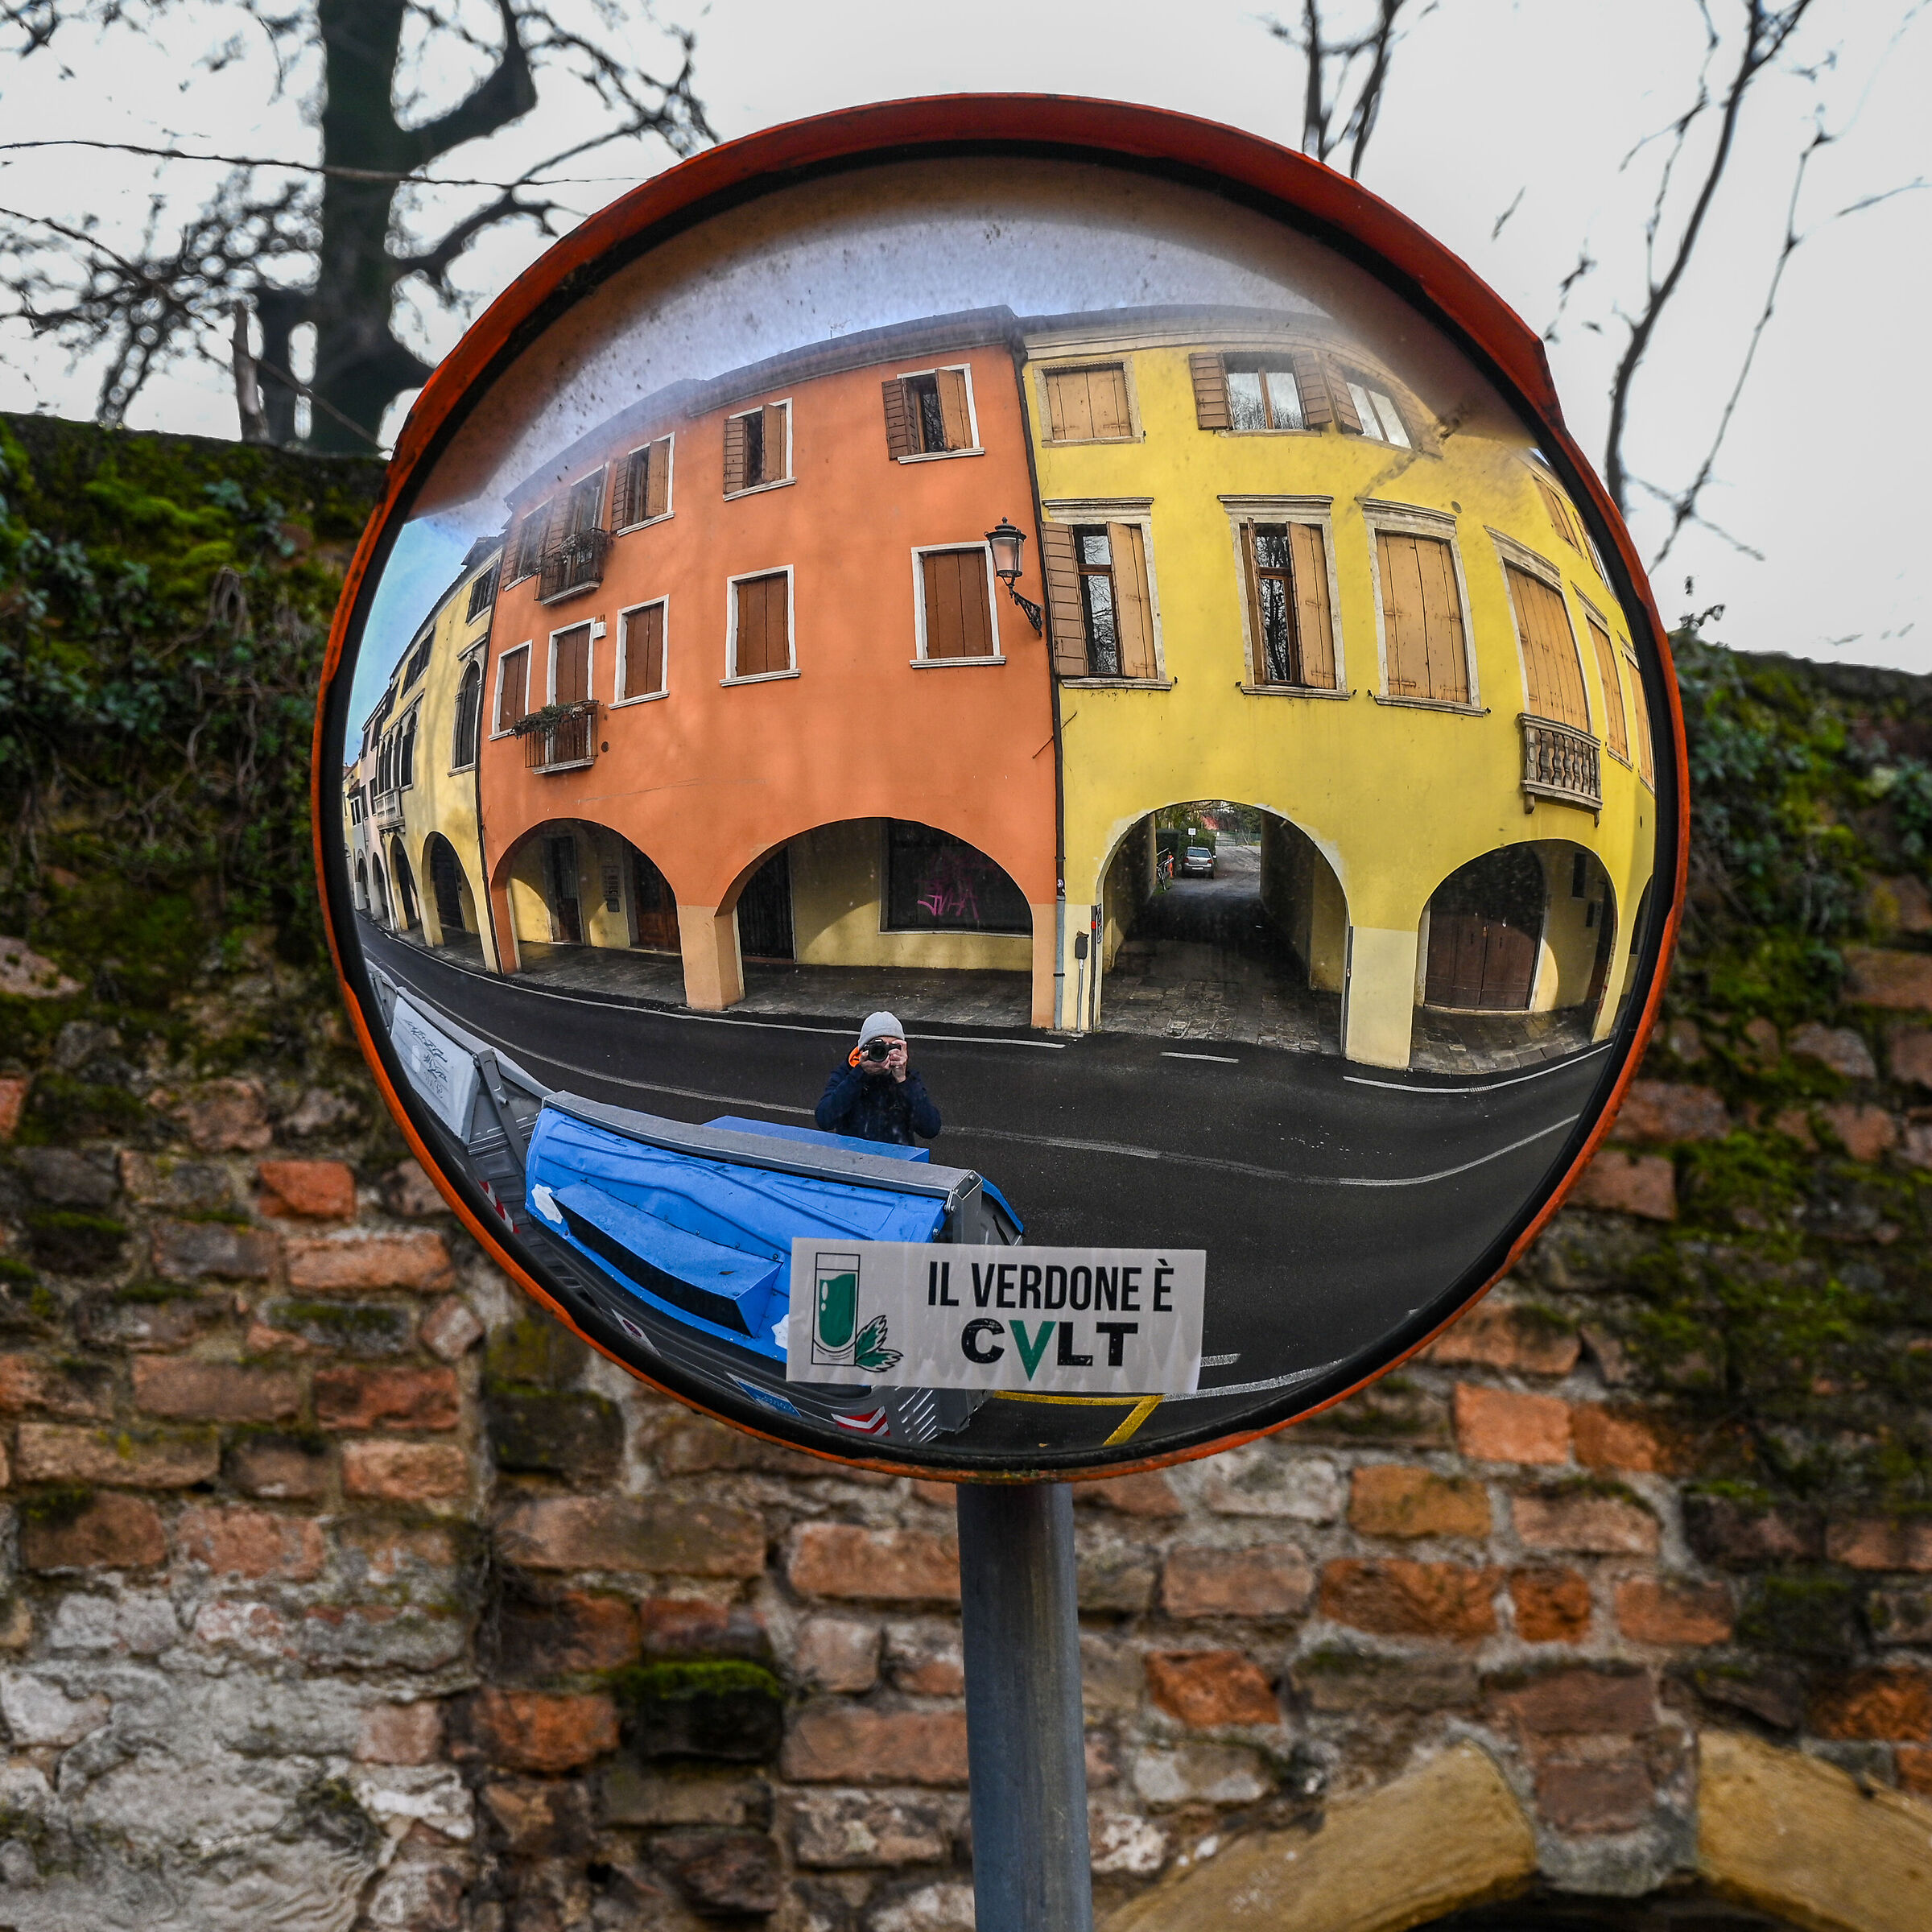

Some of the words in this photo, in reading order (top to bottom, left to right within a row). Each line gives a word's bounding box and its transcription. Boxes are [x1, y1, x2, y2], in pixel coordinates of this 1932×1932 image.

[927, 1261, 960, 1307] IL
[970, 1262, 1142, 1311] VERDONE
[1152, 1257, 1174, 1312] È
[960, 1317, 1139, 1382] CVLT
